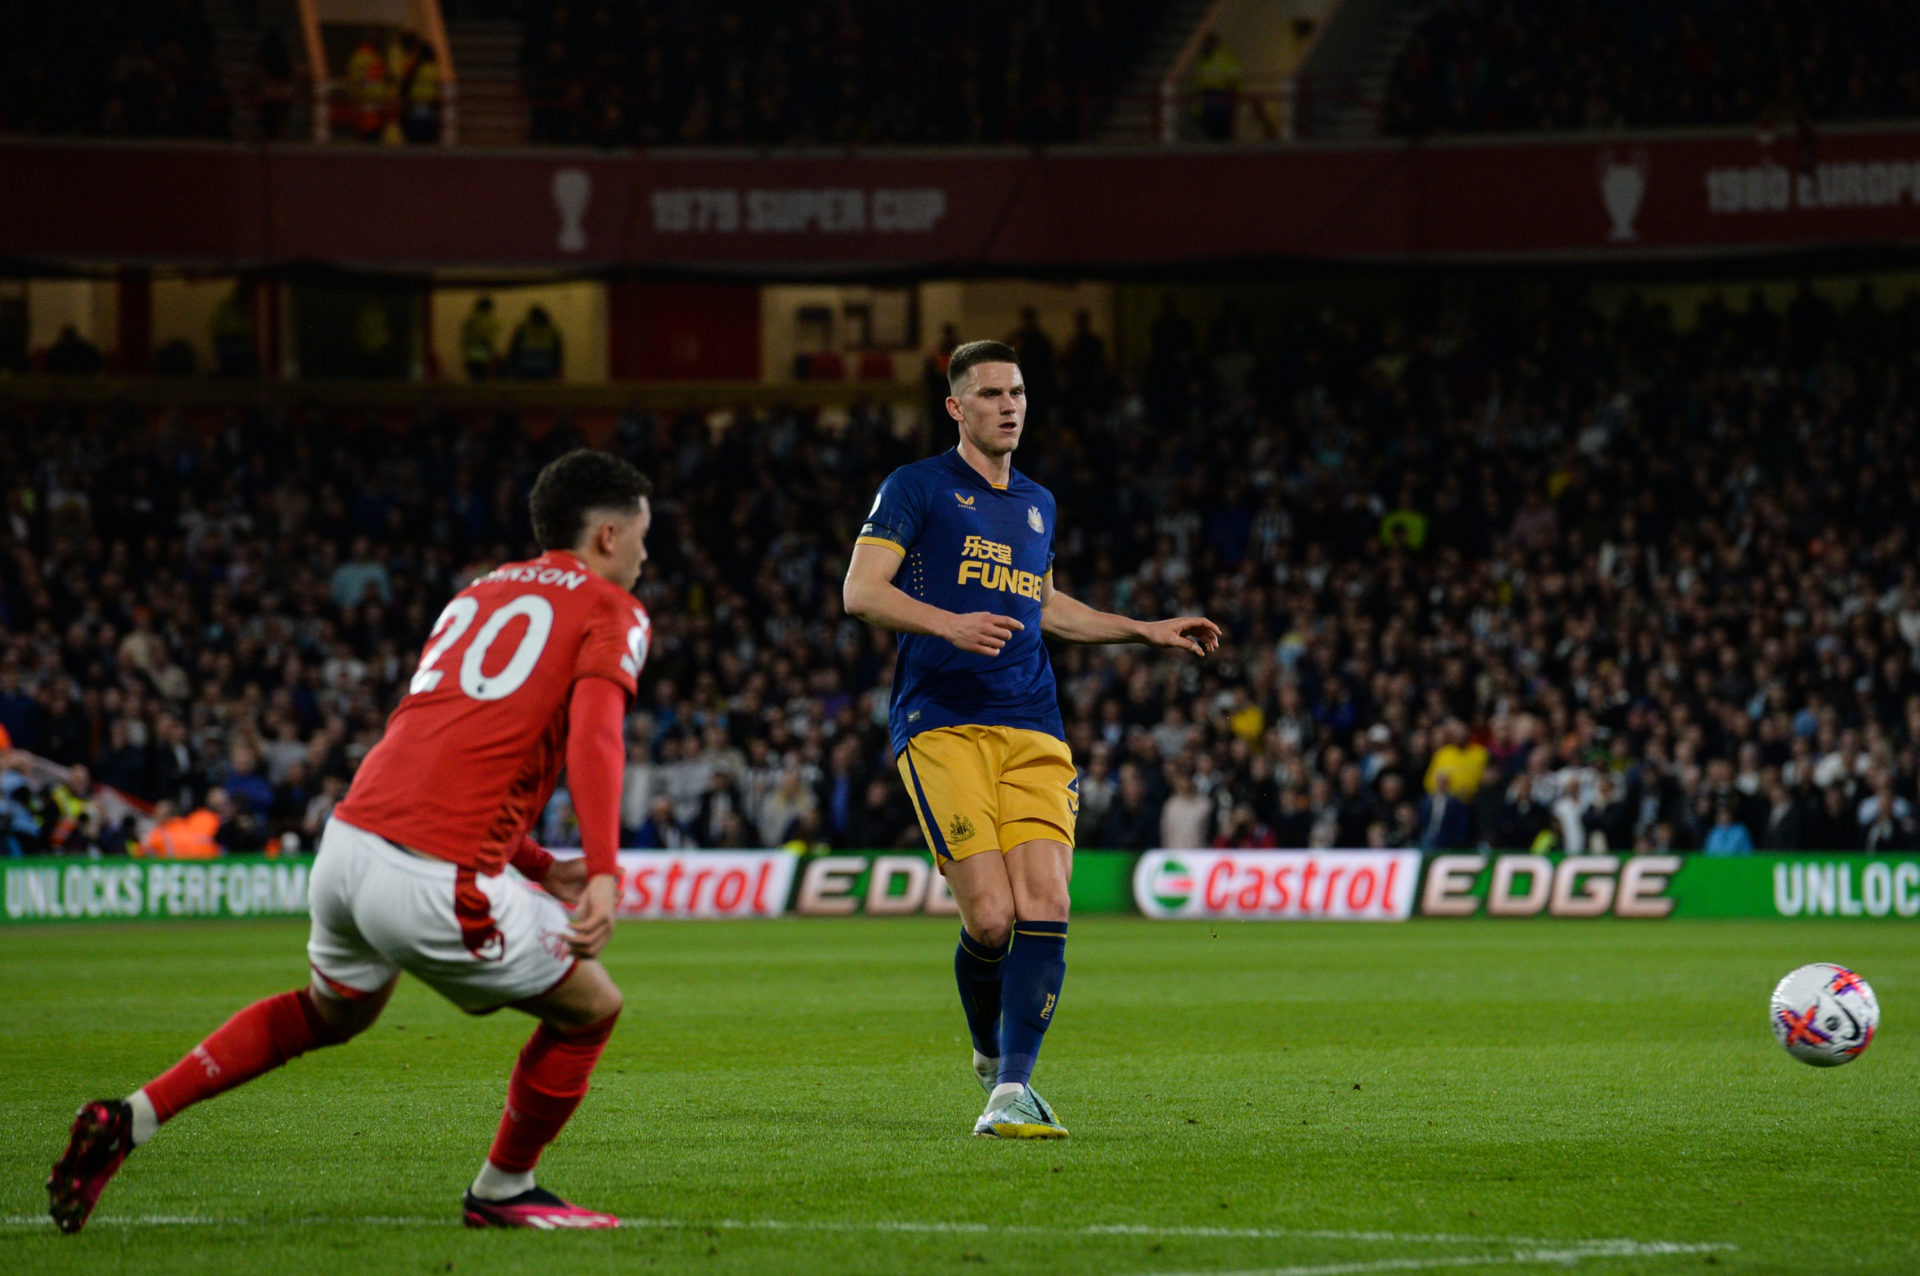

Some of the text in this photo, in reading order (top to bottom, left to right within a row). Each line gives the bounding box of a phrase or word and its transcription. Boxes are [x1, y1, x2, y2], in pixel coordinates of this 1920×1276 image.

[744, 188, 867, 233] SUPER
[872, 187, 947, 233] CUP
[961, 535, 1013, 565] 乐天堂
[409, 594, 554, 701] 20
[5, 863, 144, 919] UNLOCKS
[1204, 853, 1683, 917] Castrol EDGE
[1772, 861, 1920, 918] UNLOC
